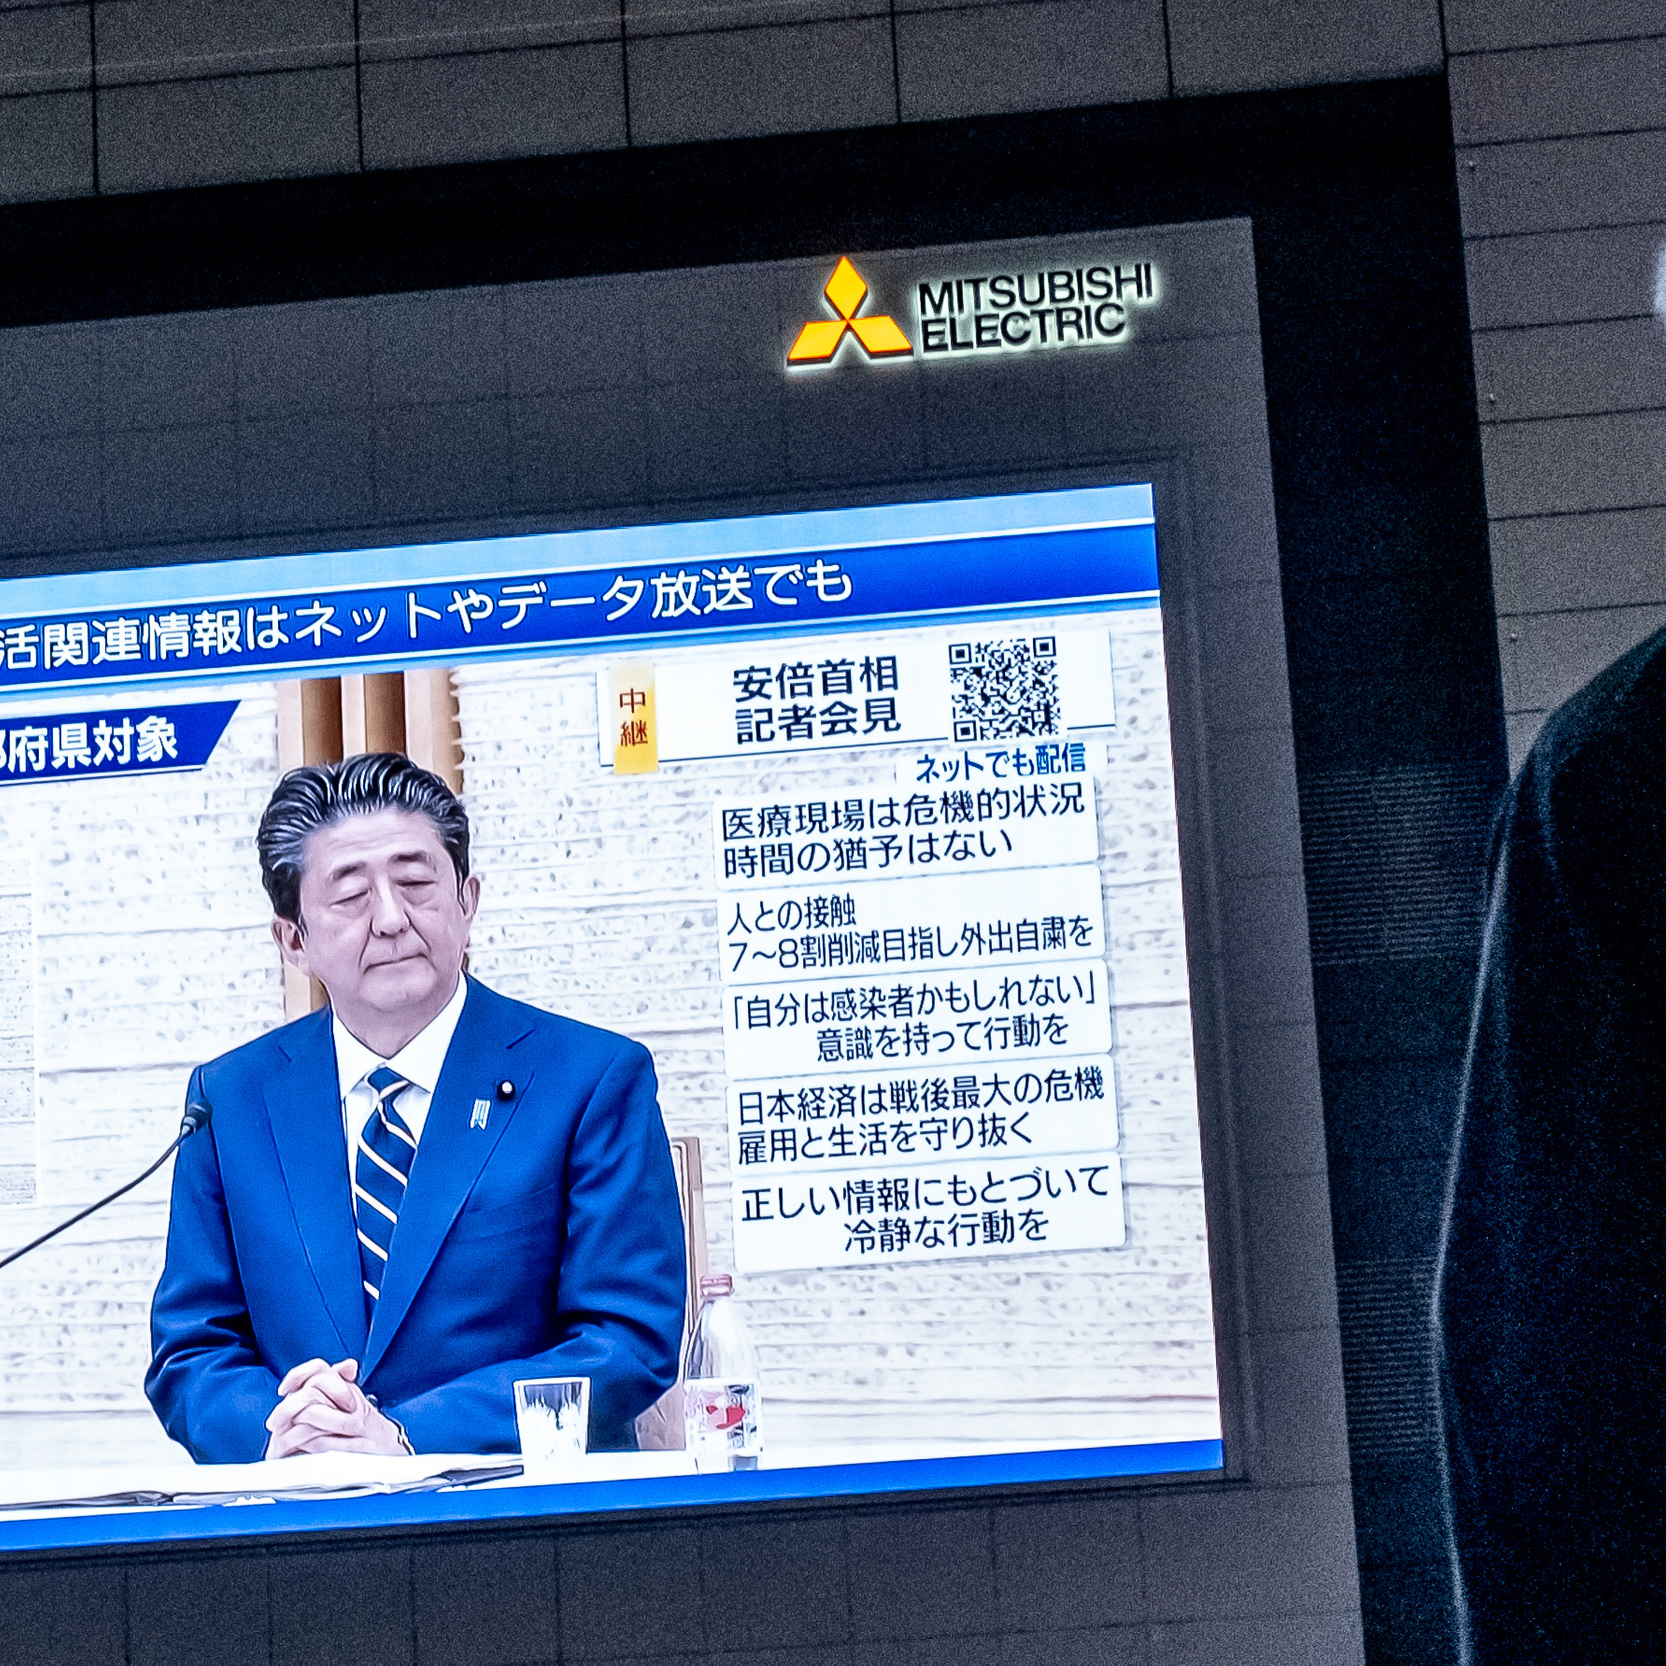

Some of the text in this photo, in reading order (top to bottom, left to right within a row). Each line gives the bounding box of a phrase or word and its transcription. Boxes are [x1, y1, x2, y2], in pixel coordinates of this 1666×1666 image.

[918, 263, 1153, 316] MITSUBISHI
[921, 302, 1126, 353] ELECTRIC
[732, 655, 900, 703] 安倍首相
[618, 685, 650, 750] 中継
[734, 697, 902, 744] 記者会見
[915, 741, 1087, 784] ネットでも配信
[722, 781, 1085, 841] 医療現場は危機的状況
[723, 829, 1014, 881] 時間の猶予はない
[727, 893, 857, 936] 人との接触
[733, 970, 1096, 1030] 「自分は感染者かもしれない」
[816, 1012, 1069, 1063] 意識を持って行動を
[739, 1064, 1105, 1126] 日本経済は戦後最大の危機
[737, 1111, 1033, 1166] 雇用と生活を守り抜く
[741, 1164, 1110, 1222] 正しい情報にもとづいて
[844, 1207, 1050, 1255] 冷静な行動を
